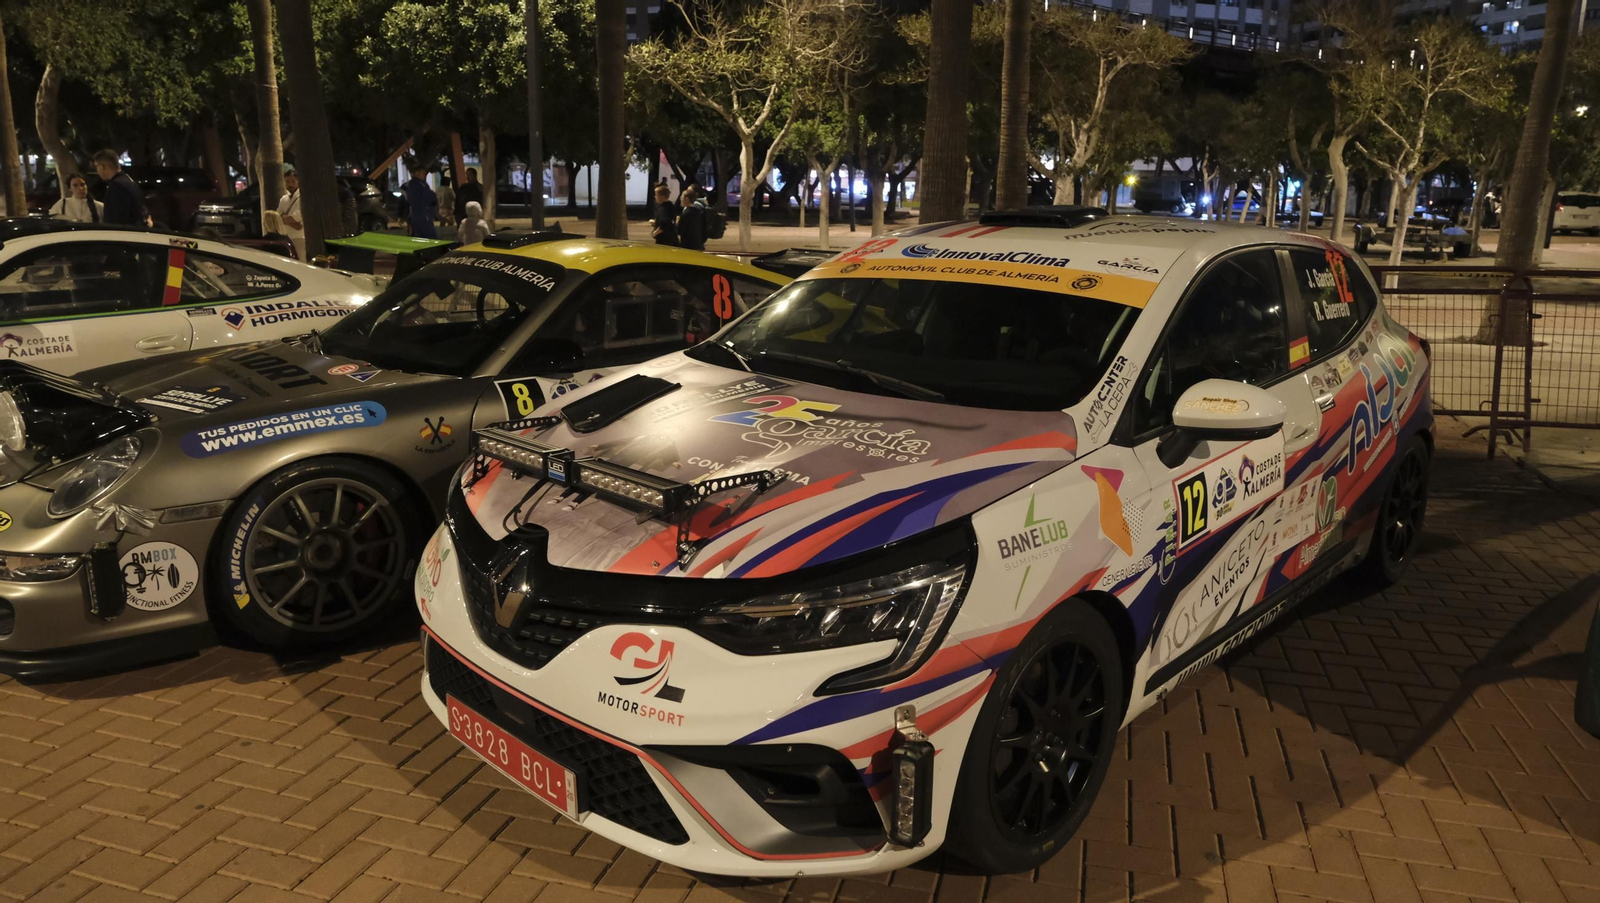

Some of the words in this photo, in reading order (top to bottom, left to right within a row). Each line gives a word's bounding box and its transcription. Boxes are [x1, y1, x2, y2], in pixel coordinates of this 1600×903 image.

[867, 264, 937, 273] AUTOMÓVIL
[940, 266, 975, 275] CLUB
[976, 268, 996, 276] DE
[998, 268, 1060, 284] ALMERÍA
[935, 248, 1071, 267] InnovalClima
[474, 258, 504, 270] CLUB
[500, 264, 556, 292] ALMERÍA
[712, 273, 732, 320] 8
[20, 342, 73, 357] ALMERÍA
[26, 336, 57, 345] COSTA
[58, 335, 70, 343] DE
[511, 383, 534, 416] 8
[1099, 410, 1113, 428] LA
[1108, 376, 1132, 411] CEPA
[198, 427, 227, 440] TUS
[229, 415, 289, 434] PEDIDOS
[291, 411, 310, 421] EN
[314, 408, 332, 418] UN
[334, 404, 363, 414] CLIC
[201, 411, 365, 452] www.emmex.es
[548, 462, 564, 473] LED
[687, 456, 724, 471] CON
[1250, 465, 1281, 496] ALMERÍA
[1256, 458, 1274, 475] COSTA
[1274, 453, 1281, 465] DE
[1183, 480, 1205, 536] 12
[231, 503, 260, 580] MICHELIN
[997, 520, 1069, 560] BANELUB
[1004, 541, 1074, 571] SUMINISTROS
[1200, 520, 1265, 608] ANICETO
[169, 581, 194, 603] FITNESS
[1214, 556, 1250, 607] EVENTOS
[598, 691, 685, 726] MOTORSPORT
[521, 751, 557, 799] BCL
